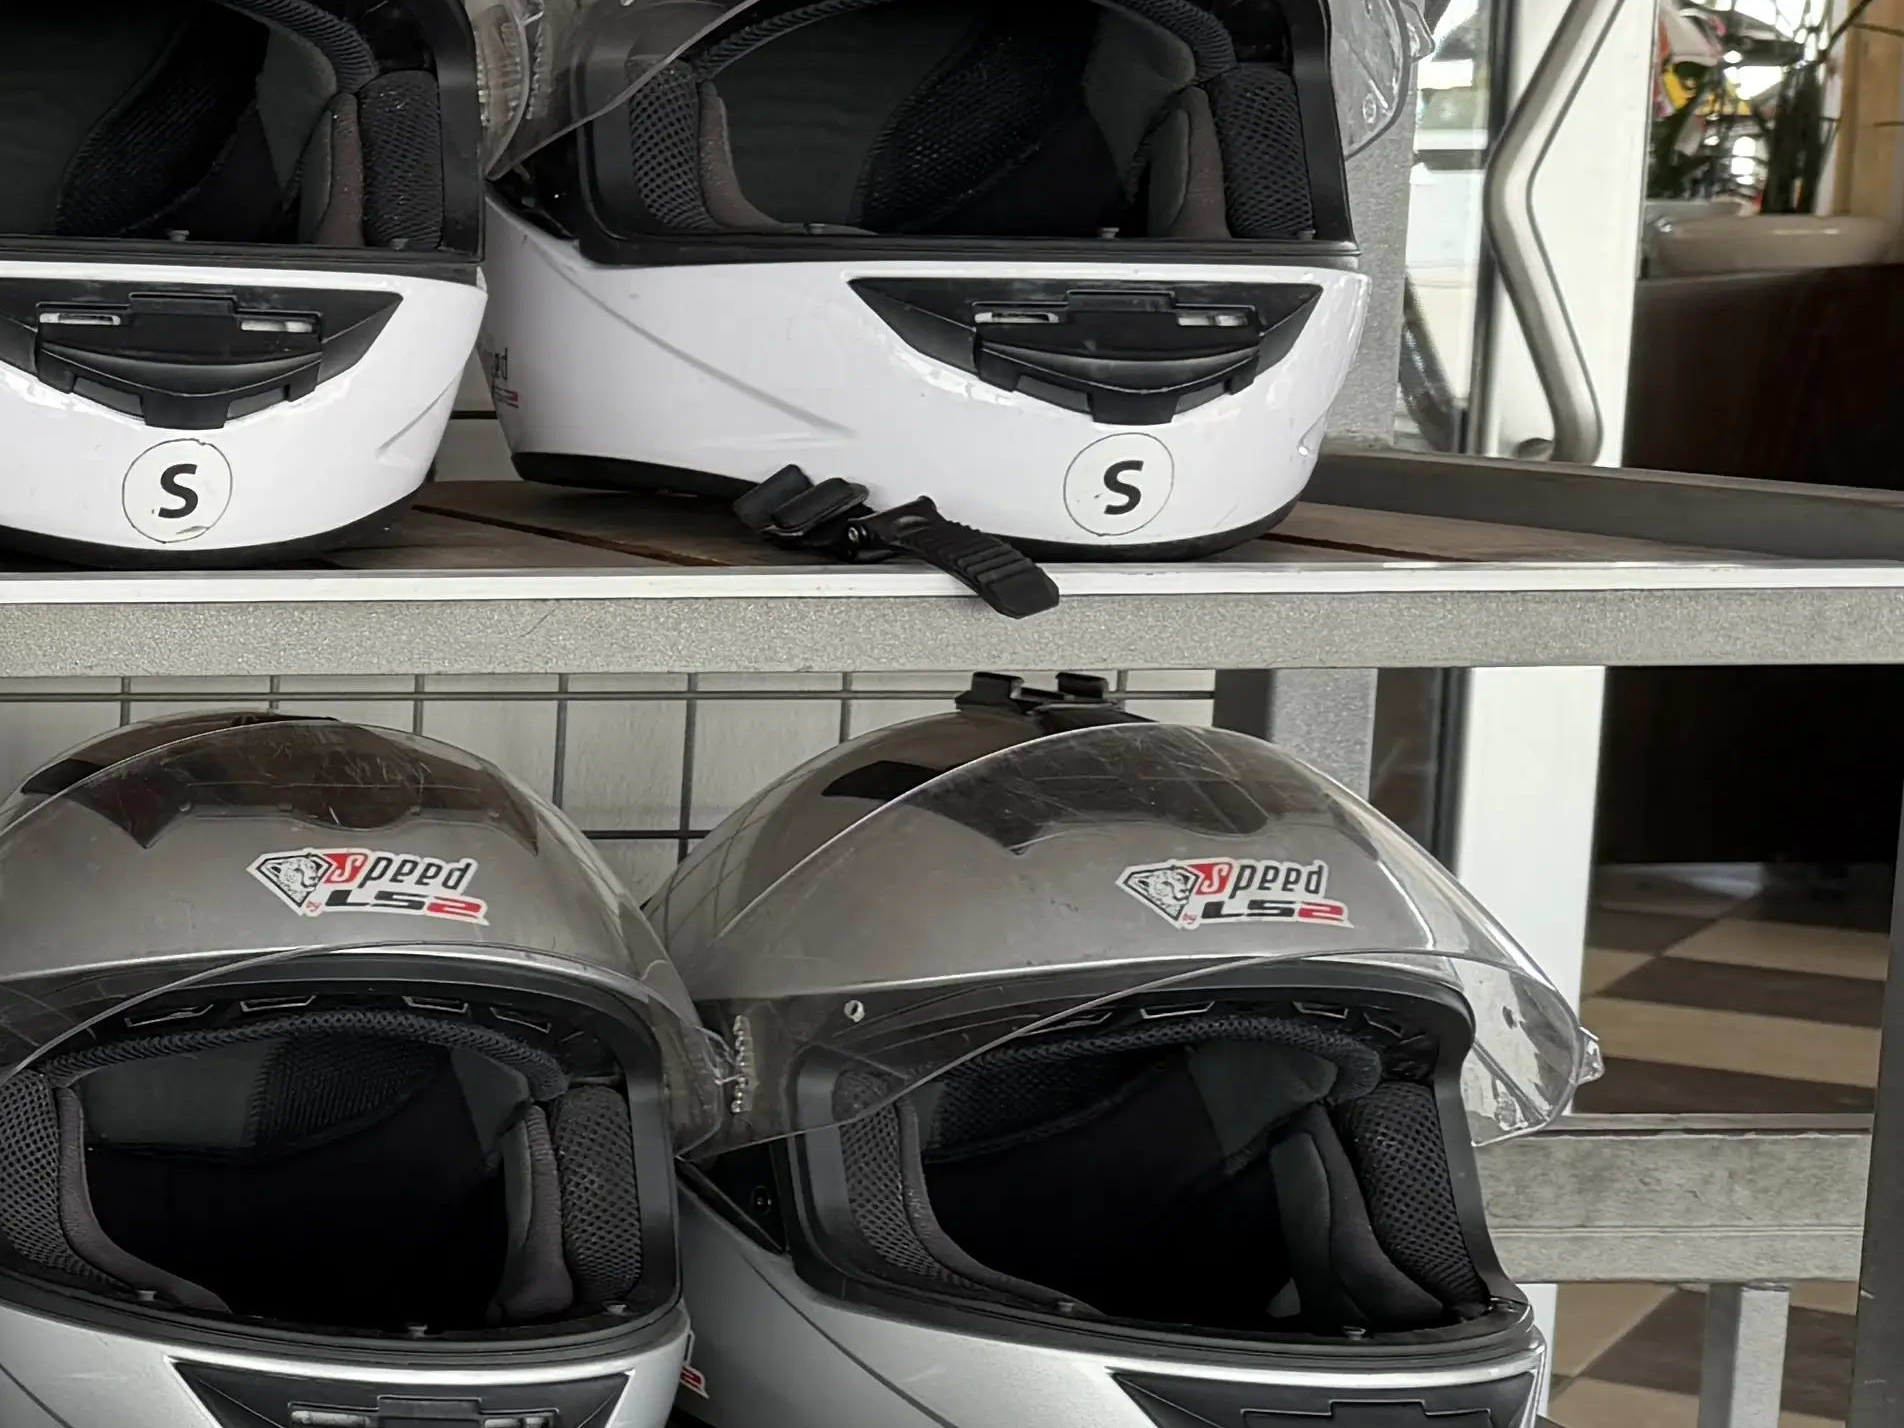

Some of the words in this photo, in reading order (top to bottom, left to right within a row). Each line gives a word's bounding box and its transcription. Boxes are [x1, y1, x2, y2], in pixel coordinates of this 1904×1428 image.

[159, 464, 198, 518] S
[1104, 461, 1143, 514] S
[325, 852, 473, 890] Speed
[1195, 862, 1324, 900] Speed
[325, 890, 482, 919] LS2
[1201, 899, 1345, 921] LS2
